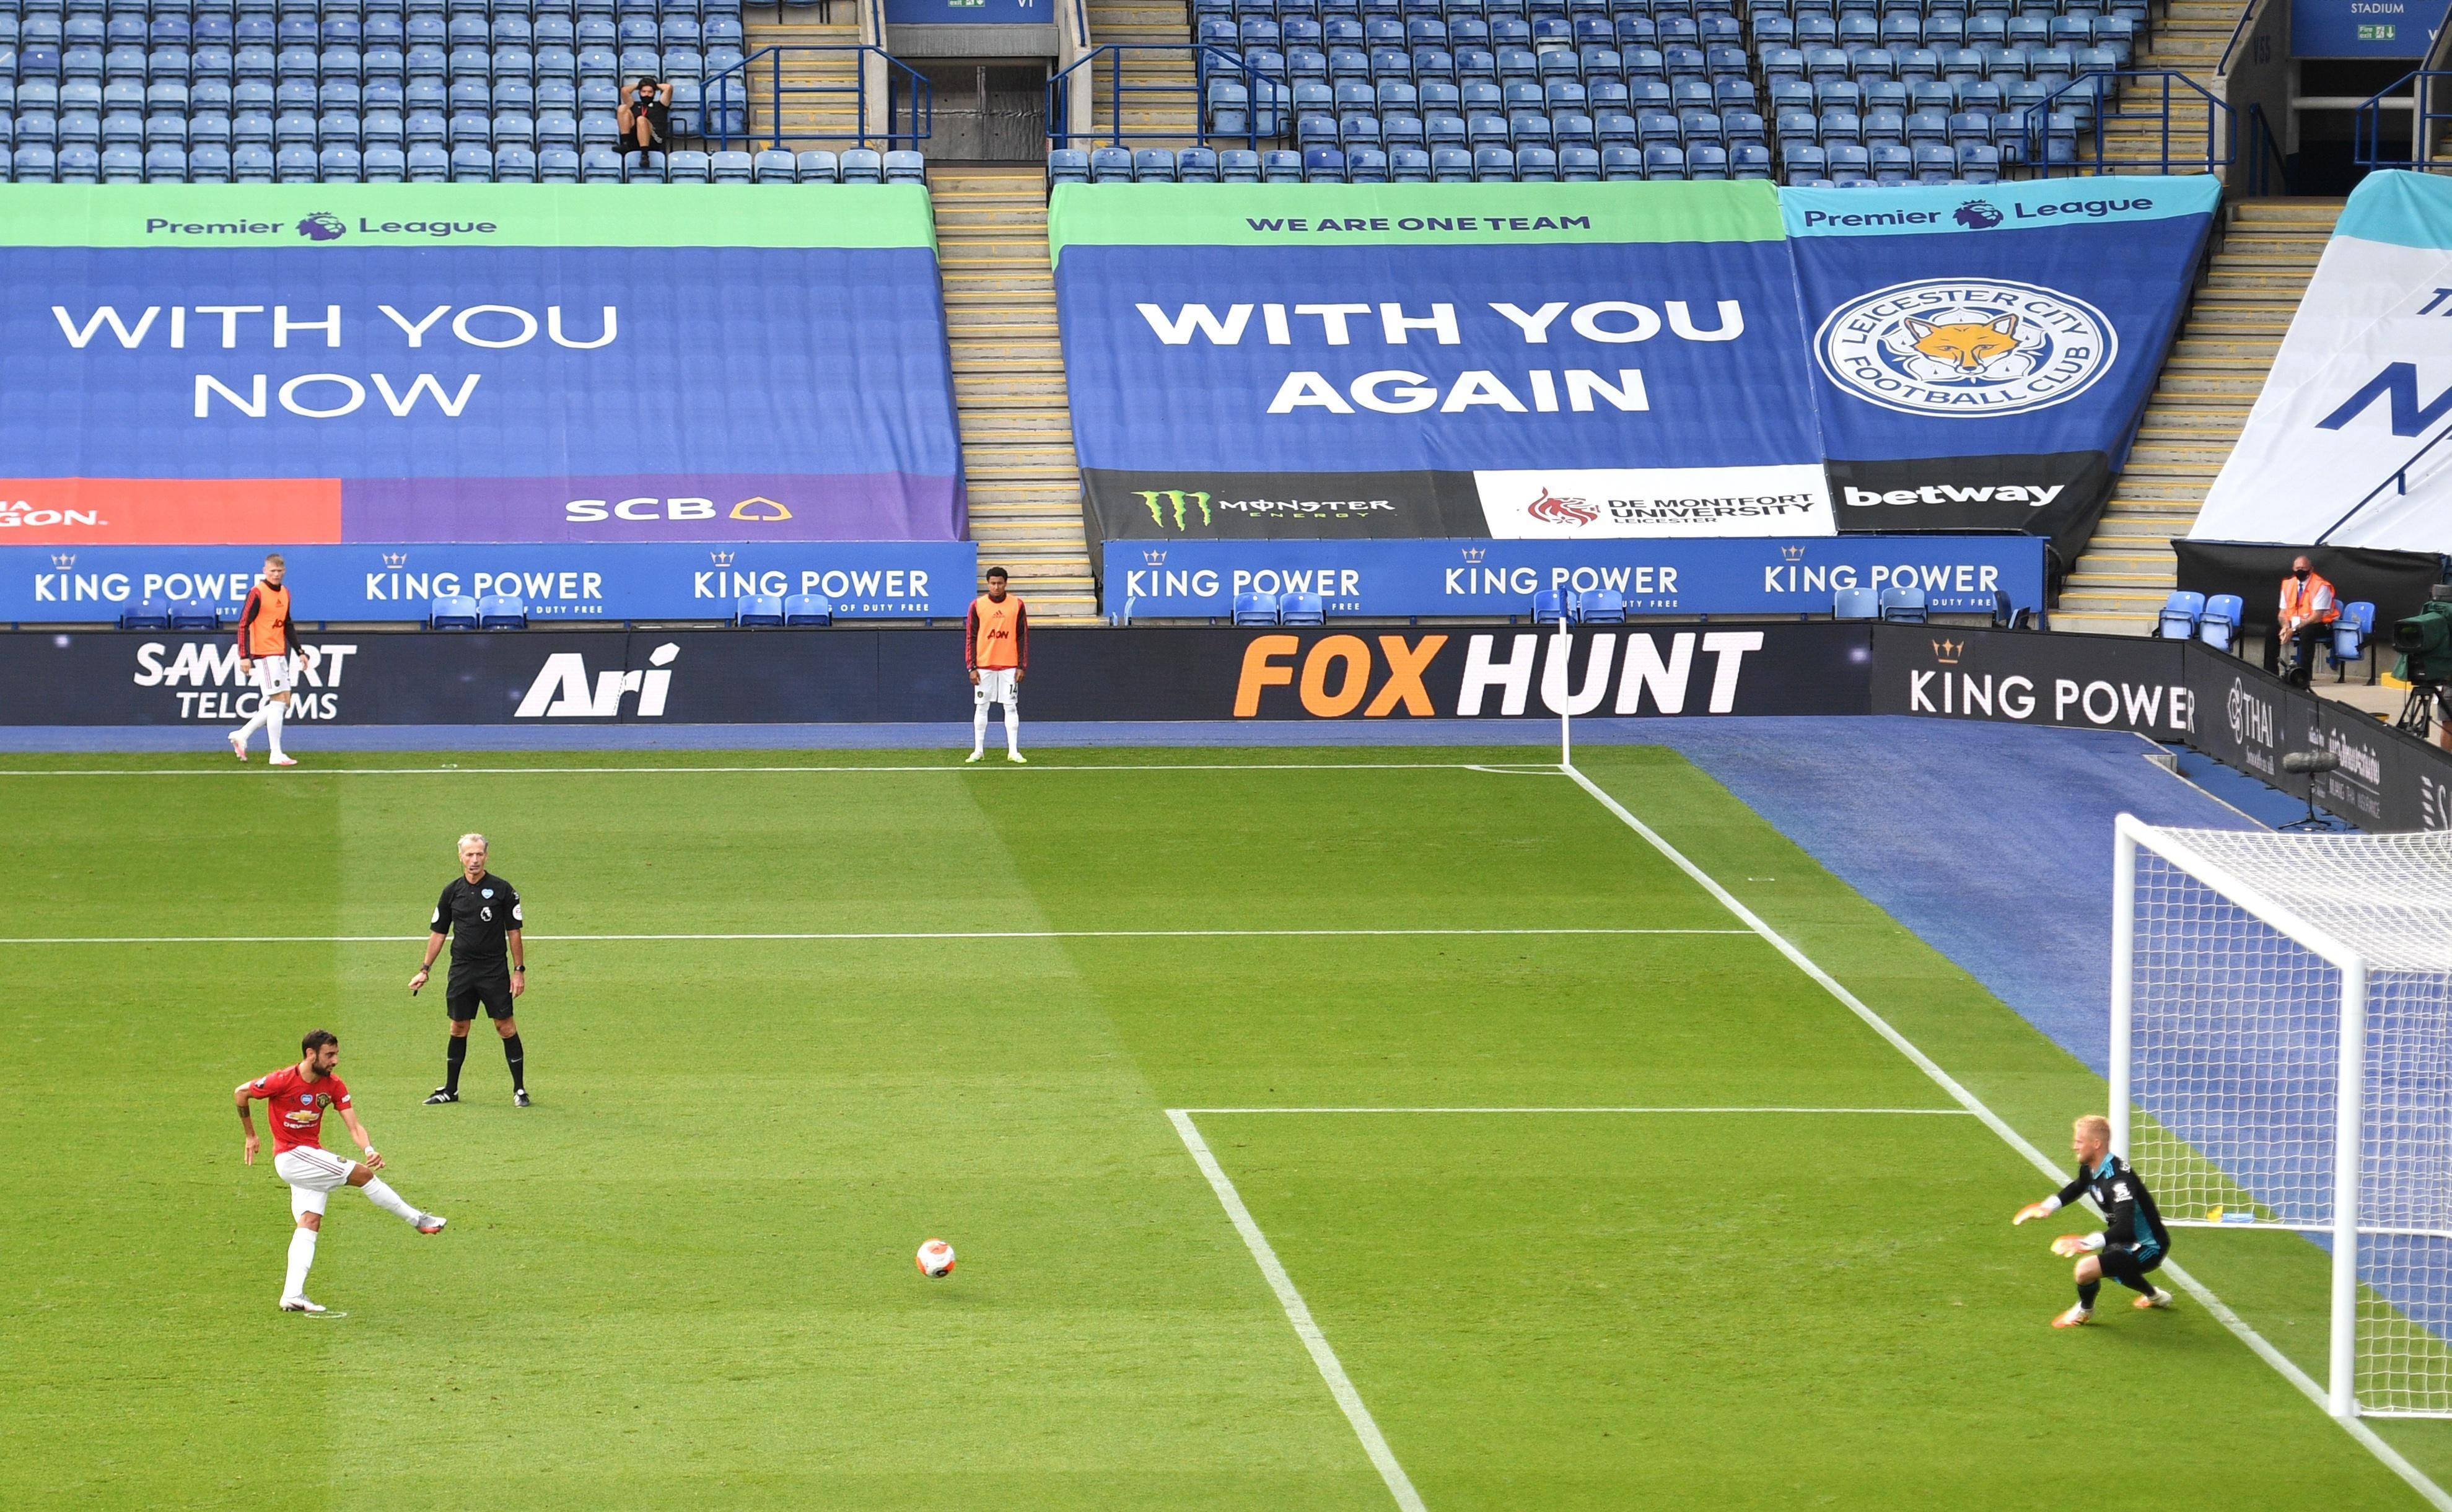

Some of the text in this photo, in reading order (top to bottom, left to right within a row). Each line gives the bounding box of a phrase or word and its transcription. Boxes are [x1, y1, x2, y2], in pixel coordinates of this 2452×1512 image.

[2350, 3, 2404, 14] STADIUM
[1245, 216, 1591, 232] WE ARE ONE TEAM
[1804, 196, 2153, 227] Premier League
[146, 217, 497, 237] Premier League
[51, 304, 617, 349] WITH YOU
[1135, 299, 1745, 346] WITH YOU
[1842, 289, 2088, 345] LEICESTER CITY
[1843, 346, 2091, 405] FOOTBALL CLUB
[194, 373, 481, 417] NOW
[1266, 368, 1650, 414] AGAIN
[565, 497, 717, 522] SCB
[1218, 499, 1396, 512] MONSTER
[1608, 494, 1813, 508] DE MONTFORT
[1844, 483, 2066, 507] betway
[1610, 502, 1815, 518] UNIVERSITY
[35, 572, 131, 602] KING
[366, 572, 603, 600] KING POWER
[694, 570, 929, 598] KING POWER
[1126, 569, 1360, 598] KING POWER
[1445, 566, 1678, 595] KING POWER
[1764, 564, 1999, 593] KING POWER
[536, 606, 567, 614] DUTY
[574, 605, 603, 614] FREE
[840, 604, 856, 612] OF
[863, 603, 893, 612] DUTY
[901, 603, 929, 611] FREE
[1332, 603, 1360, 611] FREE
[1650, 600, 1678, 608] FREE
[1932, 598, 1991, 606] DUTY FRE
[133, 642, 357, 687] SAMRT
[513, 641, 681, 717] Ari
[1233, 631, 1764, 718] FOX HUNT
[176, 691, 338, 720] TELCMS
[1910, 669, 2196, 734] KING POWER
[2243, 691, 2274, 749] THAI
